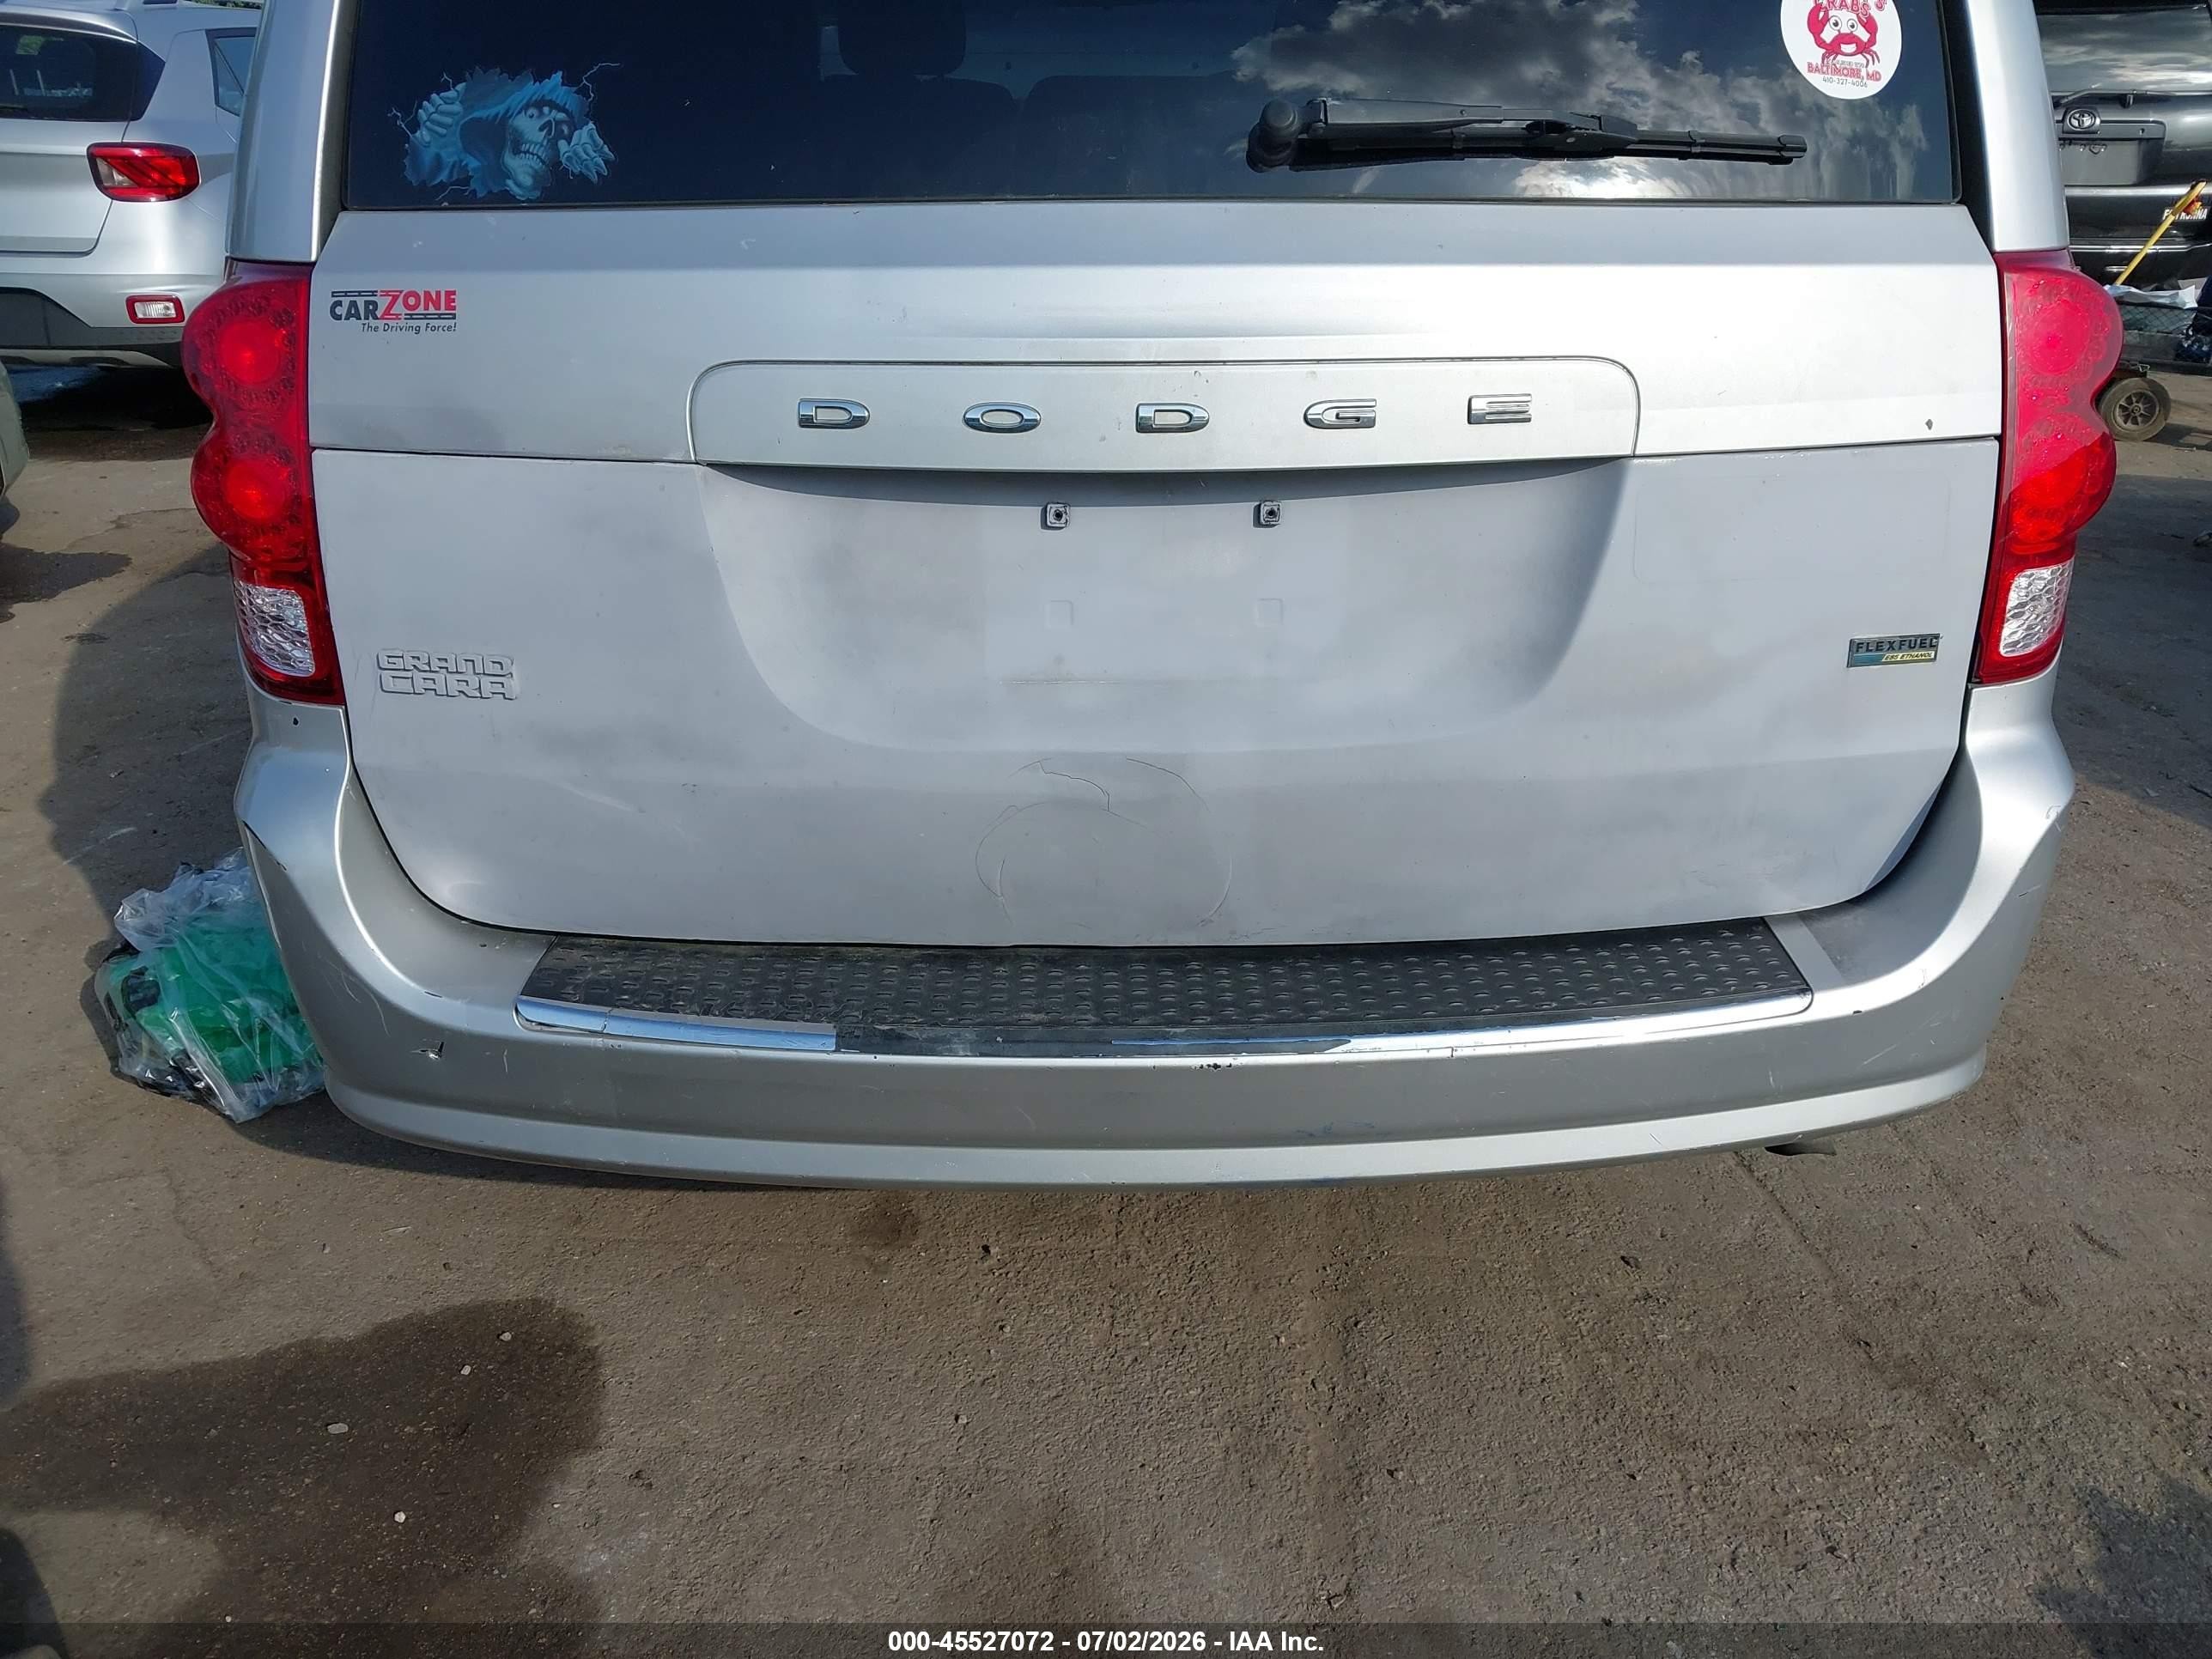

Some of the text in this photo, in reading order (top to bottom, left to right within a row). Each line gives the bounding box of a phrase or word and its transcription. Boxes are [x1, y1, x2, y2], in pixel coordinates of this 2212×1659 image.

[1807, 62, 1865, 81] BALTIMORE,
[1866, 70, 1882, 82] MD
[1822, 76, 1868, 88] 410-327-4006
[330, 289, 457, 320] CARZONE
[361, 323, 457, 334] The Driving Force!
[798, 393, 1532, 434] DODGE
[1855, 637, 1939, 653] FLEXFUEL
[376, 648, 515, 677] GRAND
[379, 672, 518, 700] CARA
